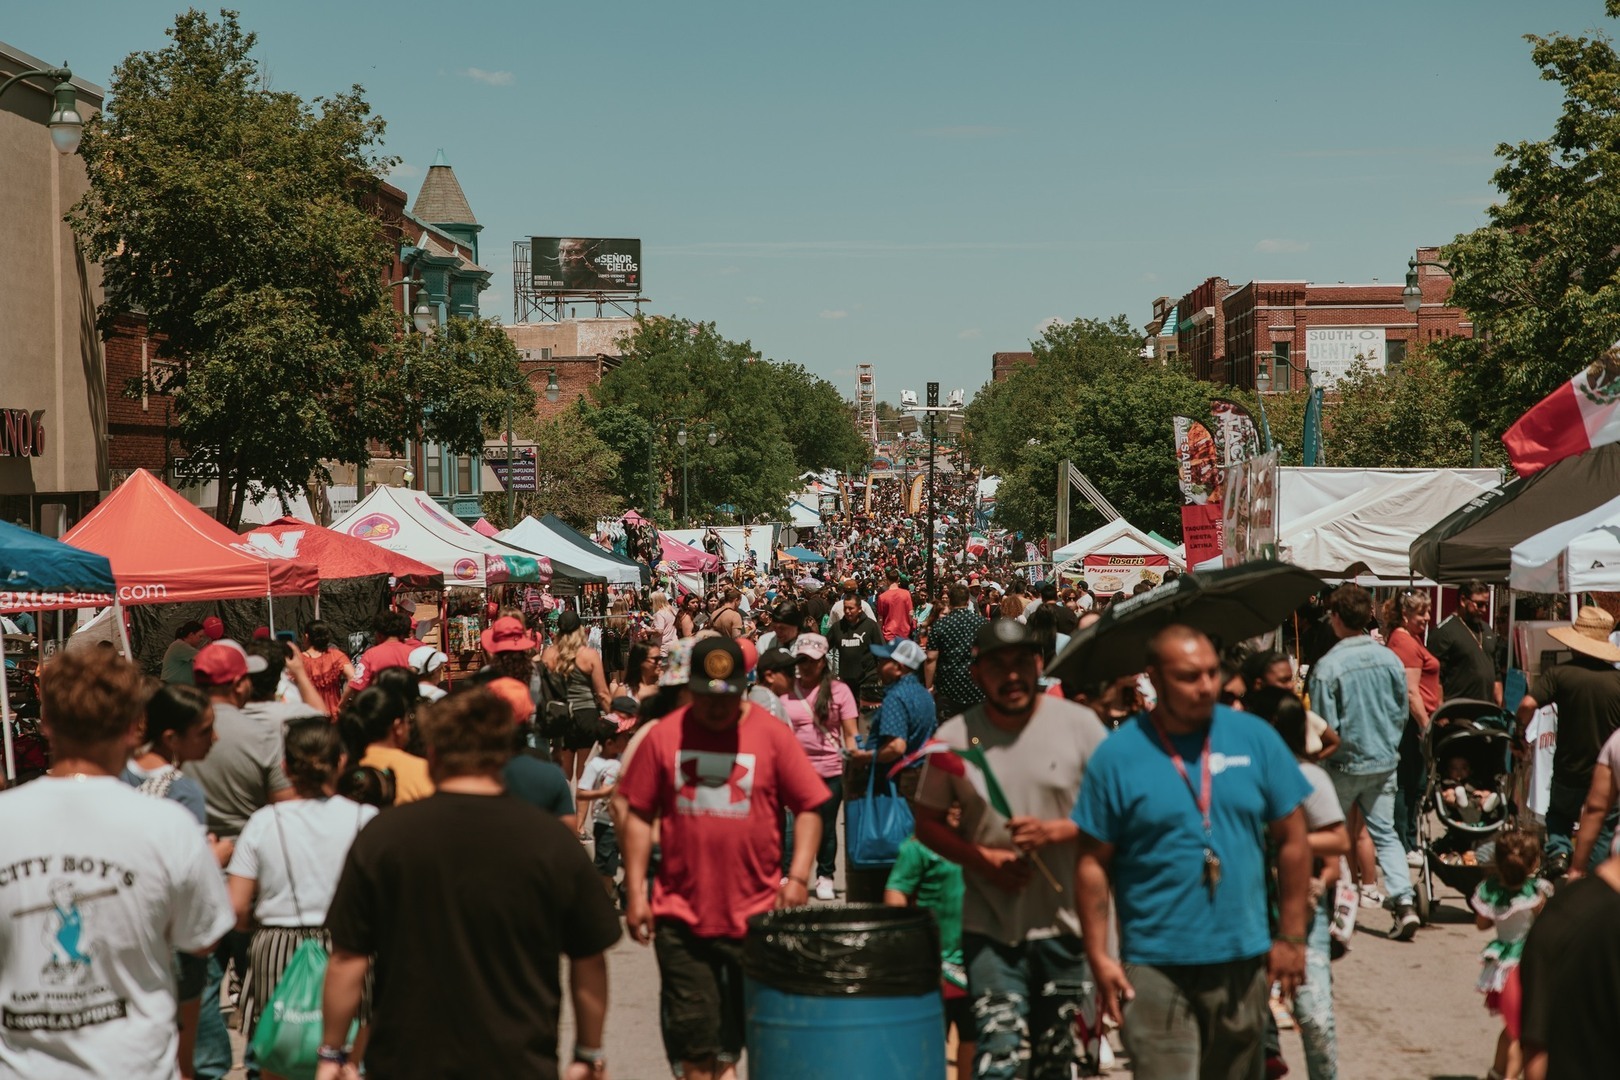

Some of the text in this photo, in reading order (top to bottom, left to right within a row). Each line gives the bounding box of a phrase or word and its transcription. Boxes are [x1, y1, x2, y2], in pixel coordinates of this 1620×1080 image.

[600, 252, 632, 264] SEÑOR
[607, 263, 638, 272] CIELOS
[1310, 330, 1353, 341] SOUTH
[1177, 416, 1194, 505] QUESABIRRIA
[1108, 556, 1145, 566] Rosaris
[841, 639, 860, 647] PUMA
[0, 857, 51, 886] CITY
